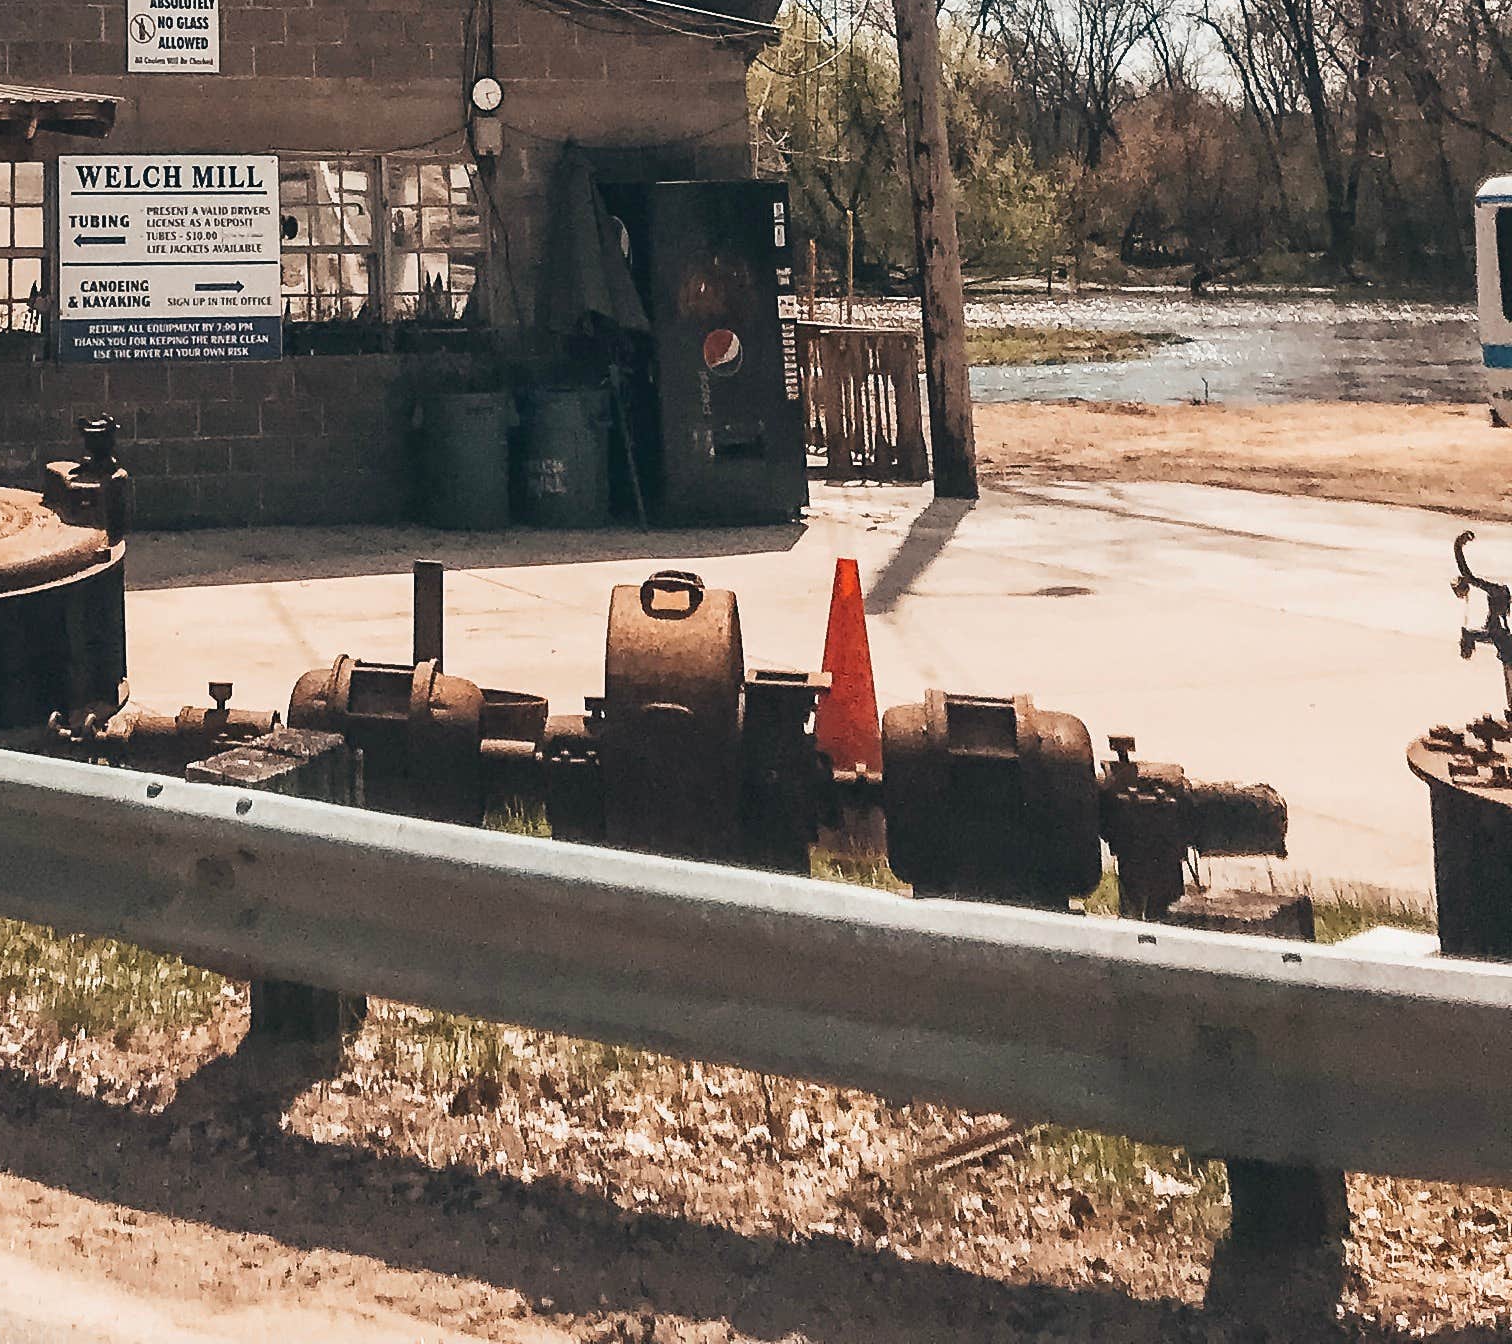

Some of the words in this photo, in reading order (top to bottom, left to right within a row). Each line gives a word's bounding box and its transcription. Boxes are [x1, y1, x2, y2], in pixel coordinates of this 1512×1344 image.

[157, 16, 173, 29] NO
[176, 16, 209, 30] GLASS
[158, 37, 208, 50] ALLOWED
[75, 165, 182, 189] WELCH
[192, 165, 263, 189] MILL
[146, 206, 188, 216] PRESENT
[192, 207, 199, 216] A
[201, 206, 228, 216] VALID
[230, 206, 271, 216] DRIVERS
[68, 214, 130, 228] TUBING
[146, 218, 186, 228] LICENSE
[189, 218, 202, 227] AS
[204, 218, 211, 227] A
[213, 218, 253, 228] DEPOSIT
[146, 231, 177, 241] TUBES
[185, 231, 218, 241] $10.00
[146, 244, 167, 254] LIFE
[169, 244, 209, 254] JACKETS
[212, 243, 263, 253] AVAILABLE
[80, 279, 149, 293] CANOEING
[67, 296, 78, 308] &
[82, 295, 151, 308] KAYAKING
[167, 297, 190, 306] SIGN
[192, 297, 206, 306] UP
[208, 297, 218, 306] IN
[220, 297, 238, 306] THE
[240, 296, 272, 306] OFFICE
[89, 324, 125, 334] RETURN
[127, 324, 144, 333] ALL
[147, 323, 200, 333] EQUIPMENT
[202, 323, 214, 332] BY
[238, 322, 254, 332] PM
[74, 338, 105, 347] THANK
[108, 338, 128, 347] YOU
[130, 337, 147, 346] FOR
[149, 336, 189, 346] KEEPING
[191, 336, 208, 345] THE
[211, 335, 238, 345] RIVER
[239, 335, 269, 344] CLEAN
[94, 350, 112, 359] USE
[115, 349, 132, 359] THE
[134, 349, 161, 358] RIVER
[163, 348, 174, 357] AT
[176, 348, 200, 357] YOUR
[203, 348, 225, 357] OWN
[227, 347, 249, 357] RISK
